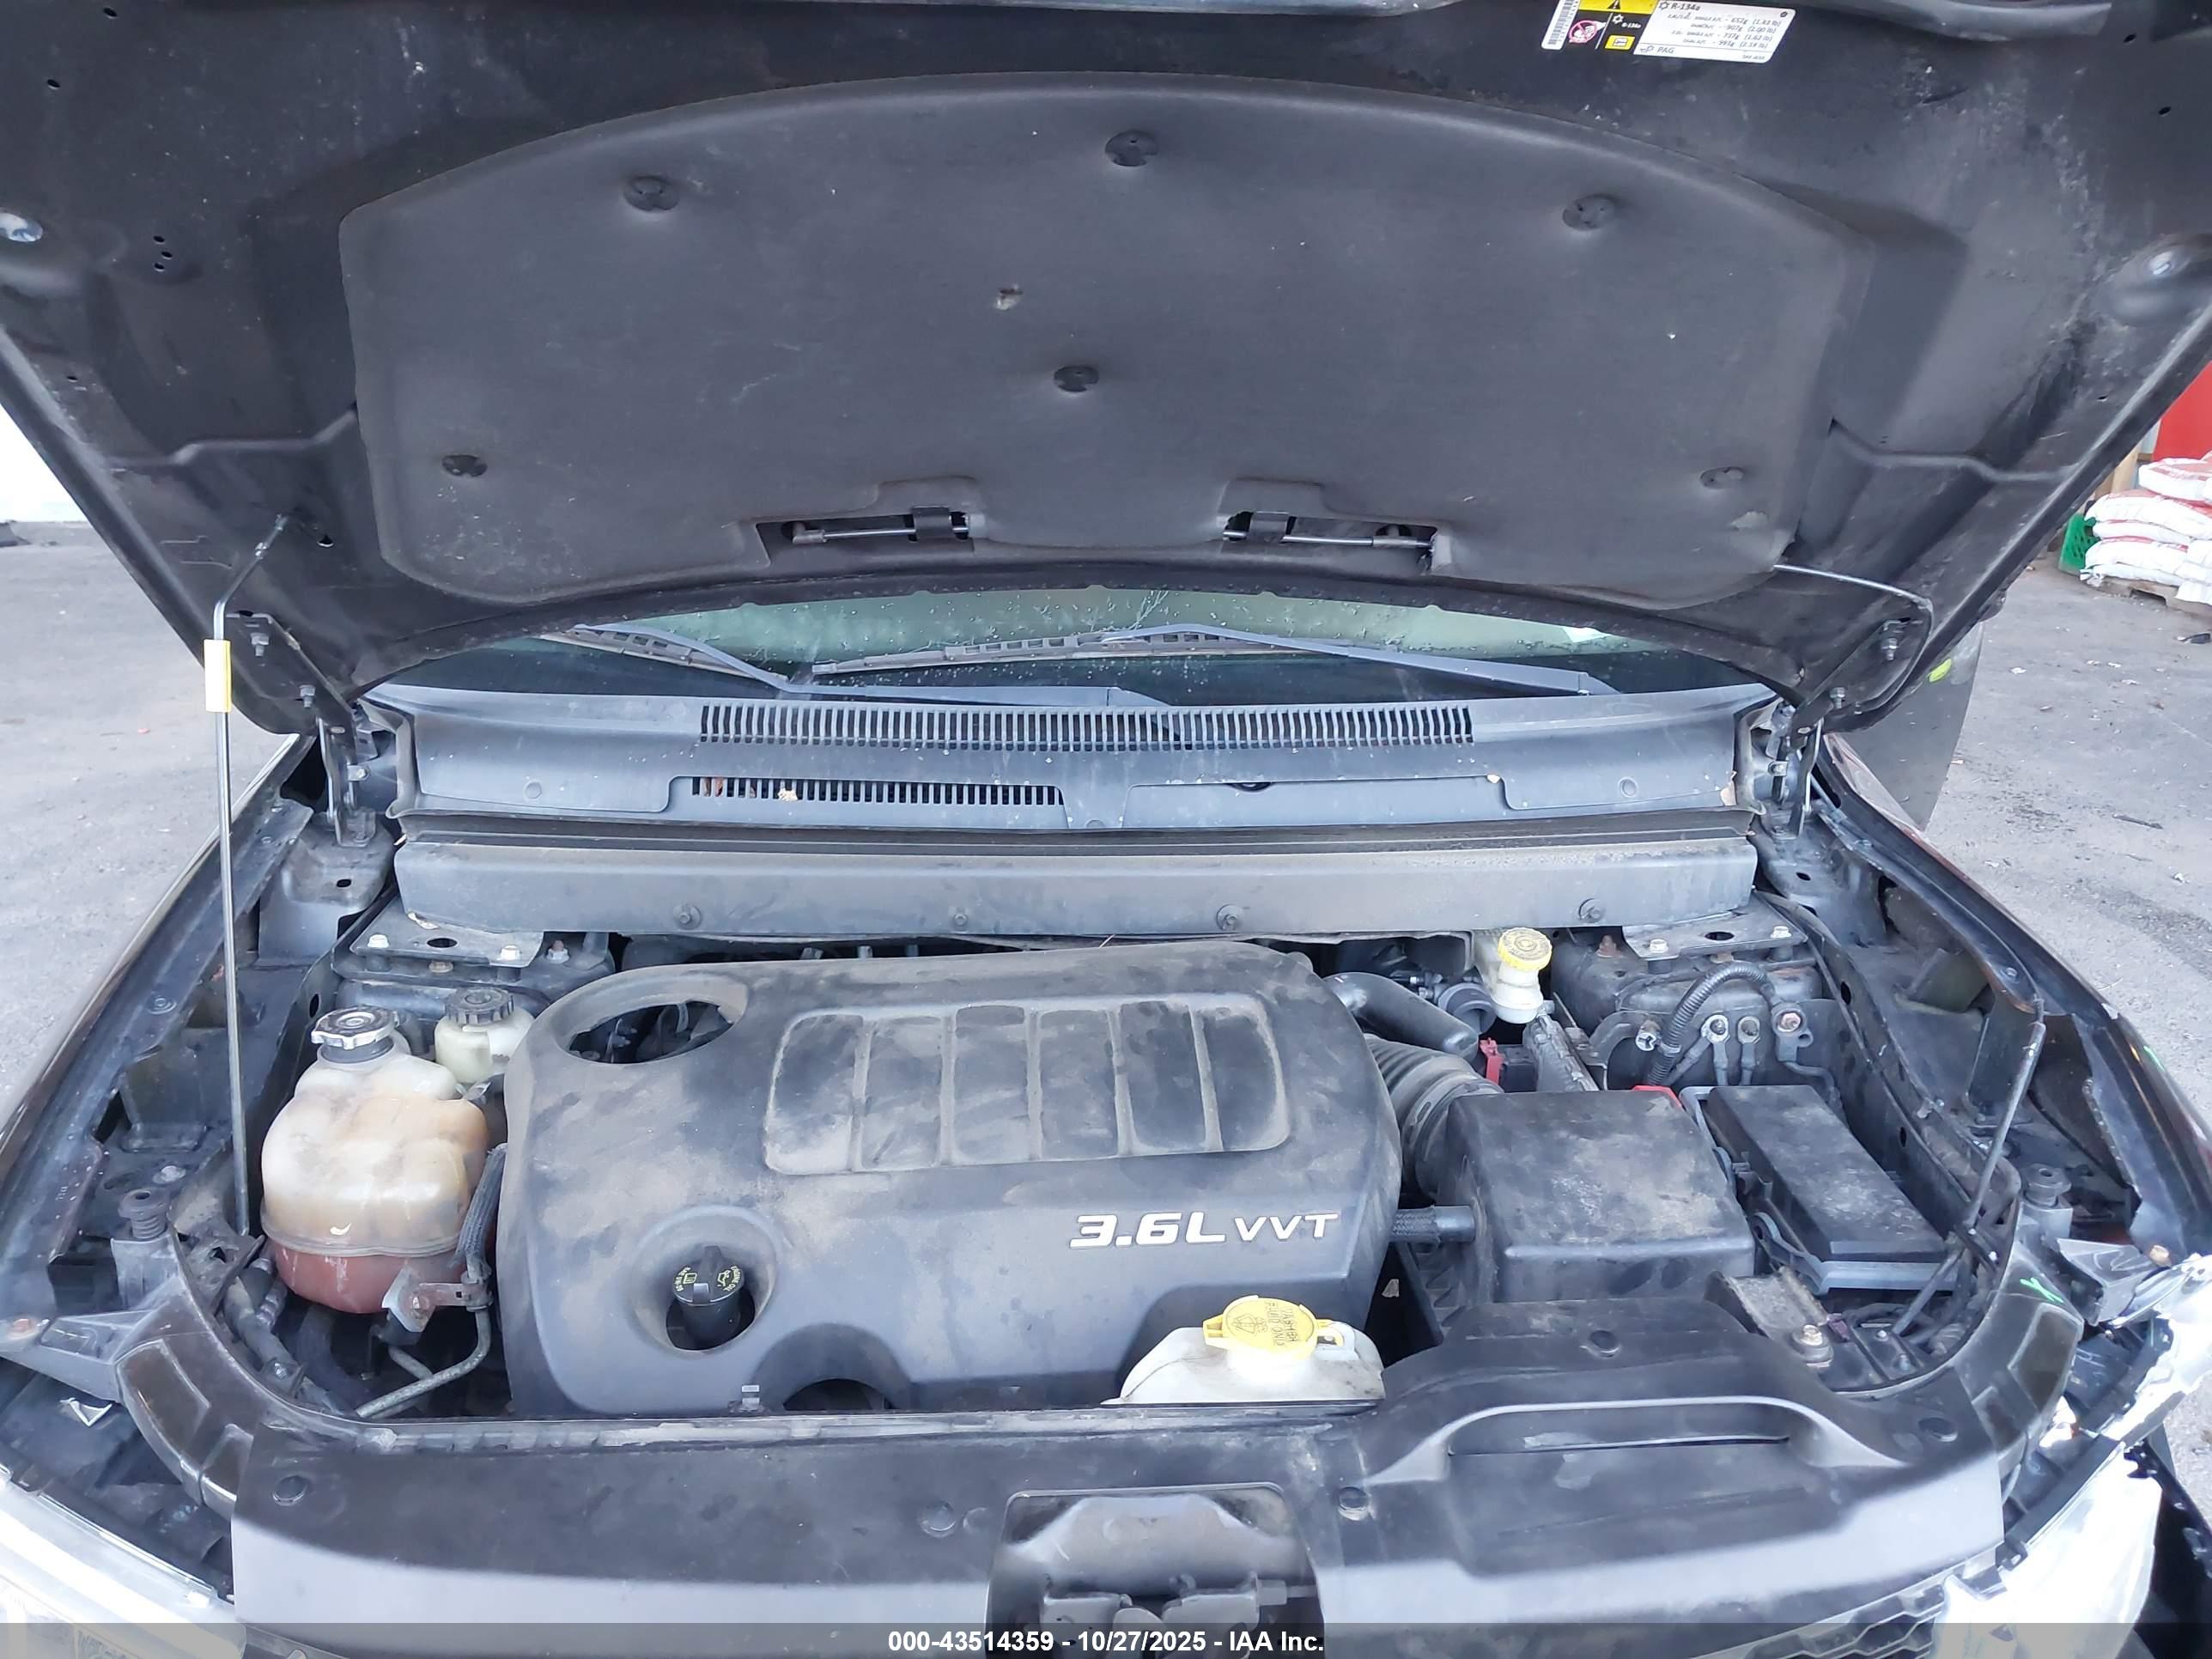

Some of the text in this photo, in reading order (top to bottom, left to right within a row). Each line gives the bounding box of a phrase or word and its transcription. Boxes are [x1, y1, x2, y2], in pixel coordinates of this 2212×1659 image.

[1670, 3, 1701, 11] R-134a
[1069, 1212, 1340, 1249] 3.6L VVT
[722, 1265, 741, 1292] ENGINE OIL
